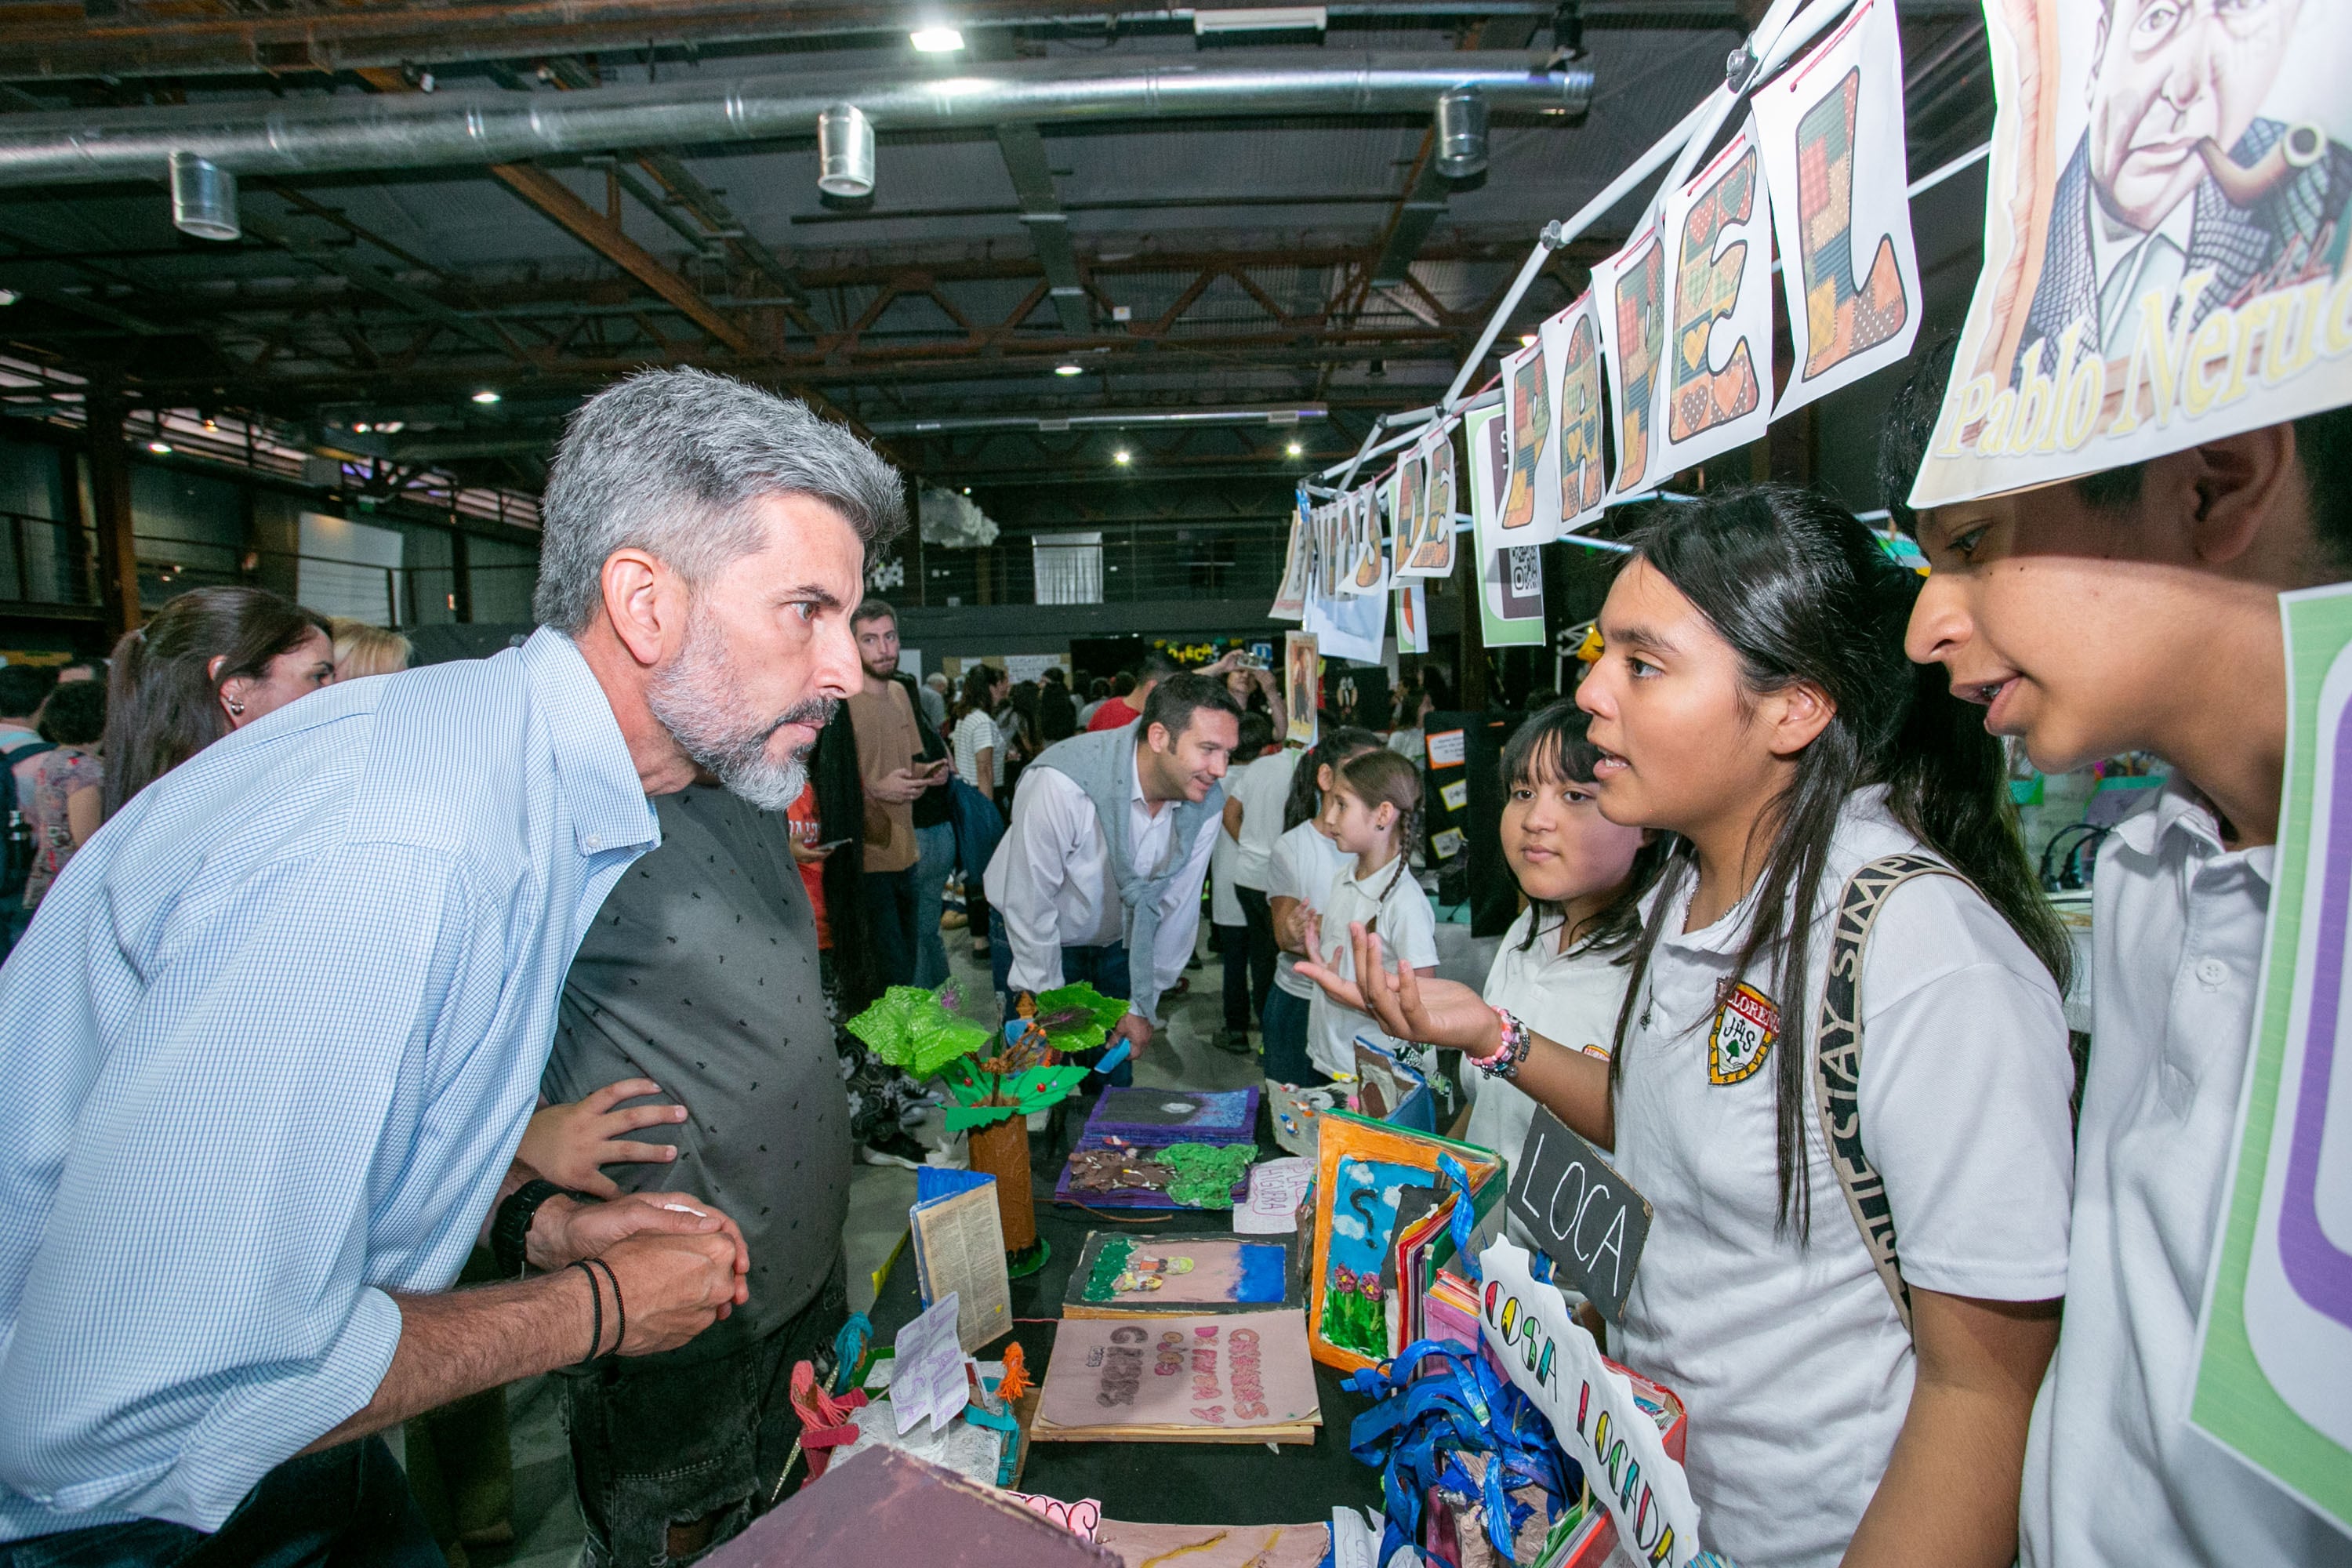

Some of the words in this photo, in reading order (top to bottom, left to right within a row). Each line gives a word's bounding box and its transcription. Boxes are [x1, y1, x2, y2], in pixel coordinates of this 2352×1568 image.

[1502, 64, 1908, 530] PAPEL
[1936, 321, 2107, 460] Pablo
[1818, 996, 1860, 1139] STAY
[1260, 1166, 1287, 1210] HIGUERA
[1519, 1133, 1628, 1298] LOCA
[1154, 1330, 1189, 1376] OJOS
[1190, 1404, 1227, 1424] Y
[1484, 1279, 1559, 1403] COSA
[1576, 1379, 1675, 1568] LOCADA
